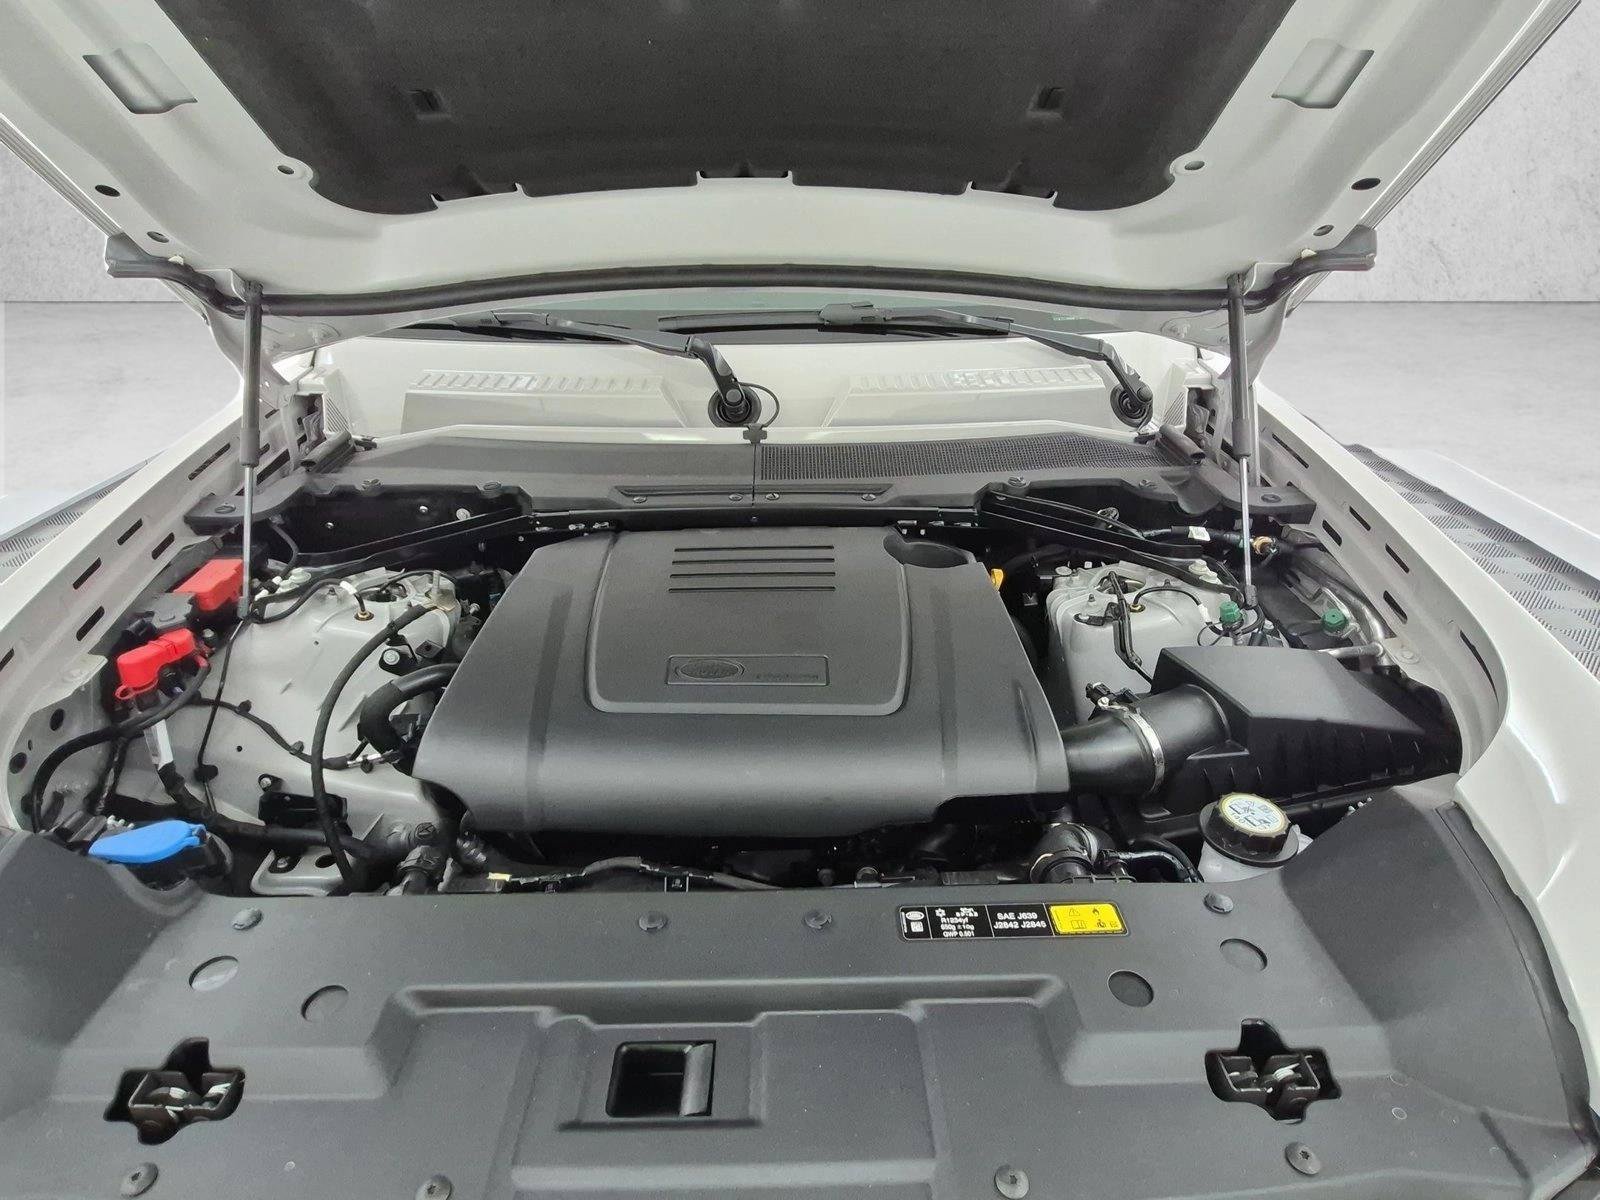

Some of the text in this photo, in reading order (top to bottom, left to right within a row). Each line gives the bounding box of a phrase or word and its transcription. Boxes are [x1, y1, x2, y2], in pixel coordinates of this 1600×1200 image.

[997, 912, 1038, 920] SAE J639
[993, 921, 1019, 929] J2842
